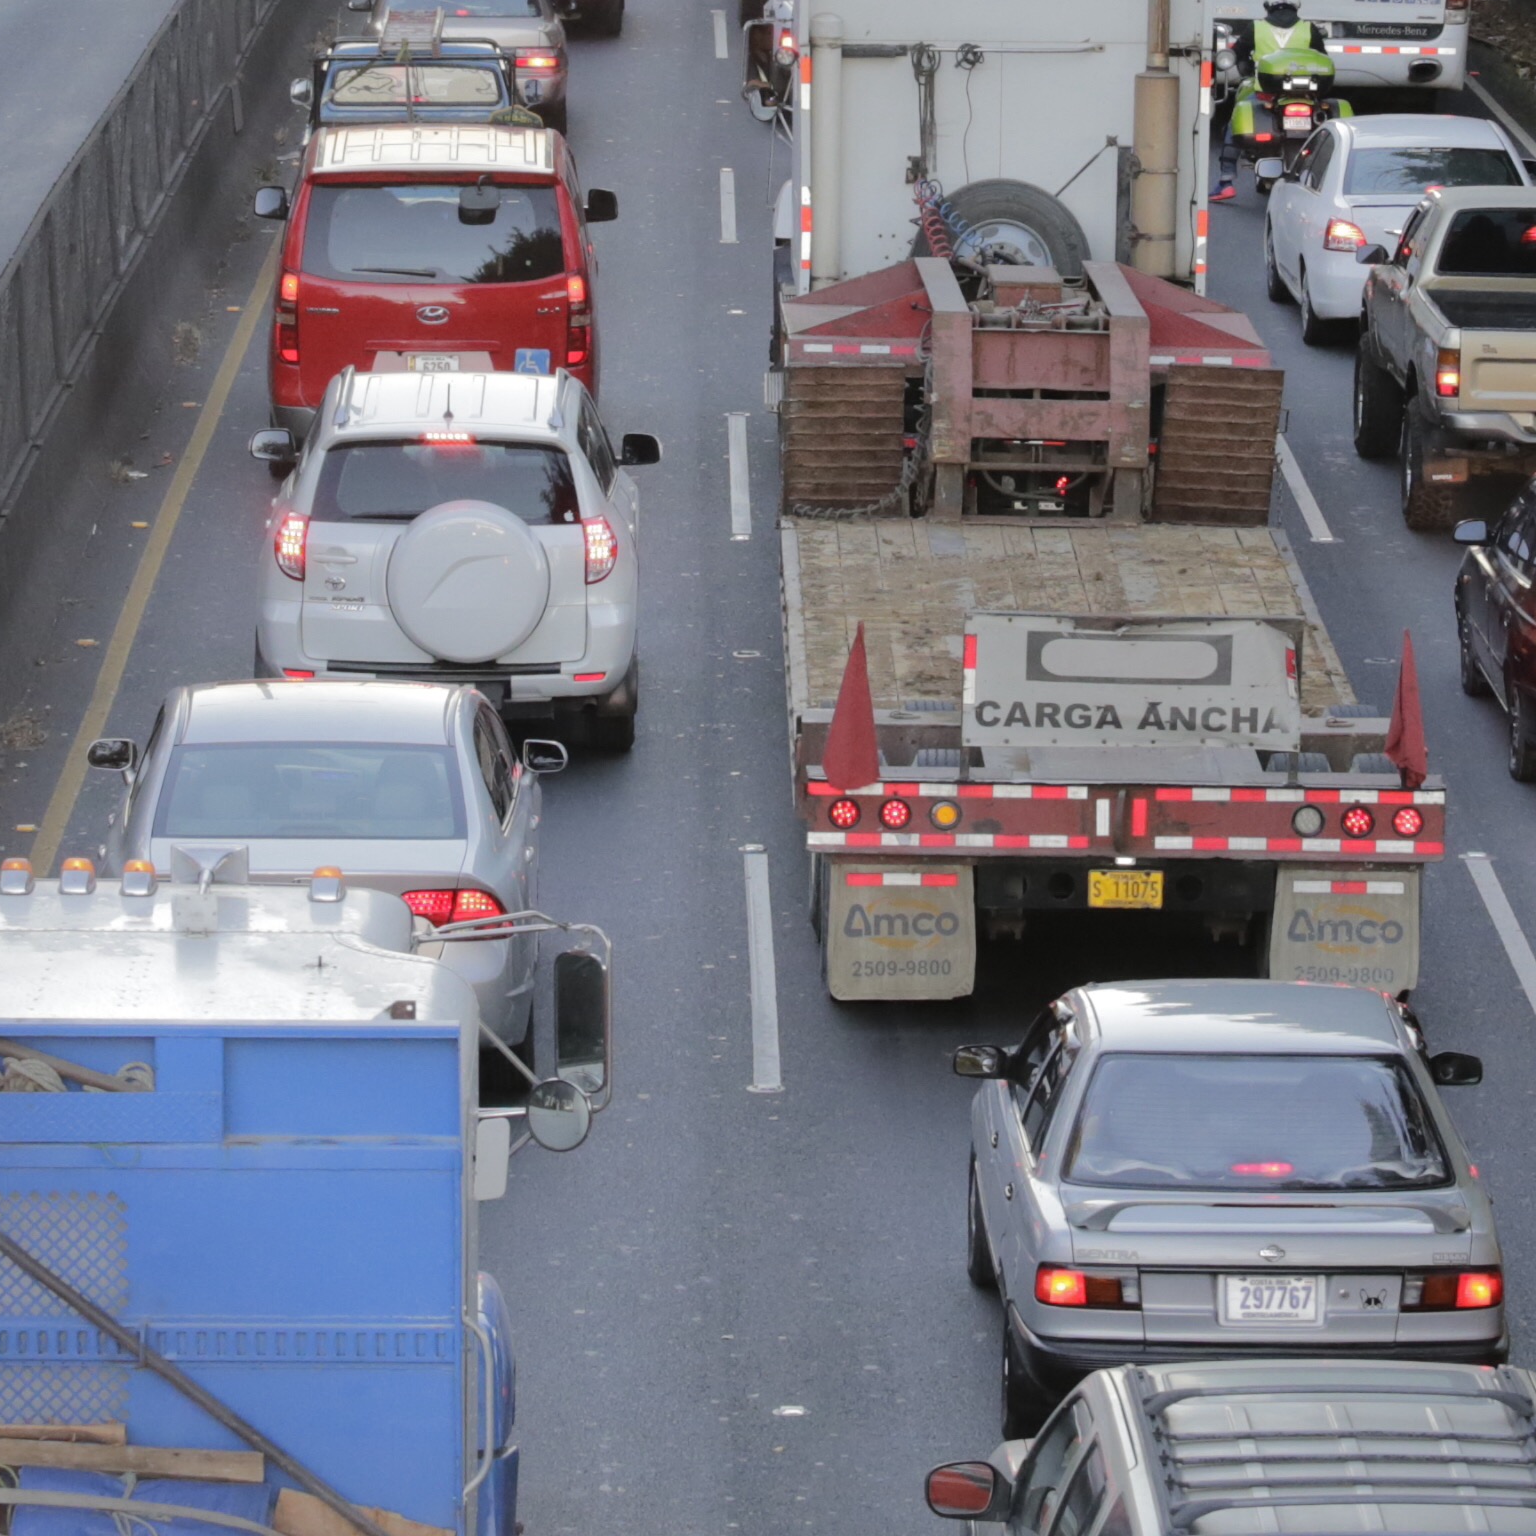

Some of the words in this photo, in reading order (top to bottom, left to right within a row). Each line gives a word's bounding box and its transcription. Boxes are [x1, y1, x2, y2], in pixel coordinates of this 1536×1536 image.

[1356, 25, 1428, 37] Mercedes-Benz
[975, 700, 1123, 730] CARGA
[1137, 702, 1291, 734] ANCHA
[1093, 880, 1102, 898] S
[1114, 880, 1159, 899] 11075
[843, 903, 960, 937] Amco
[1287, 909, 1404, 944] Amco
[852, 959, 952, 977] 2509-9800
[1076, 1248, 1140, 1260] SENTRA
[1240, 1286, 1313, 1310] 297767
